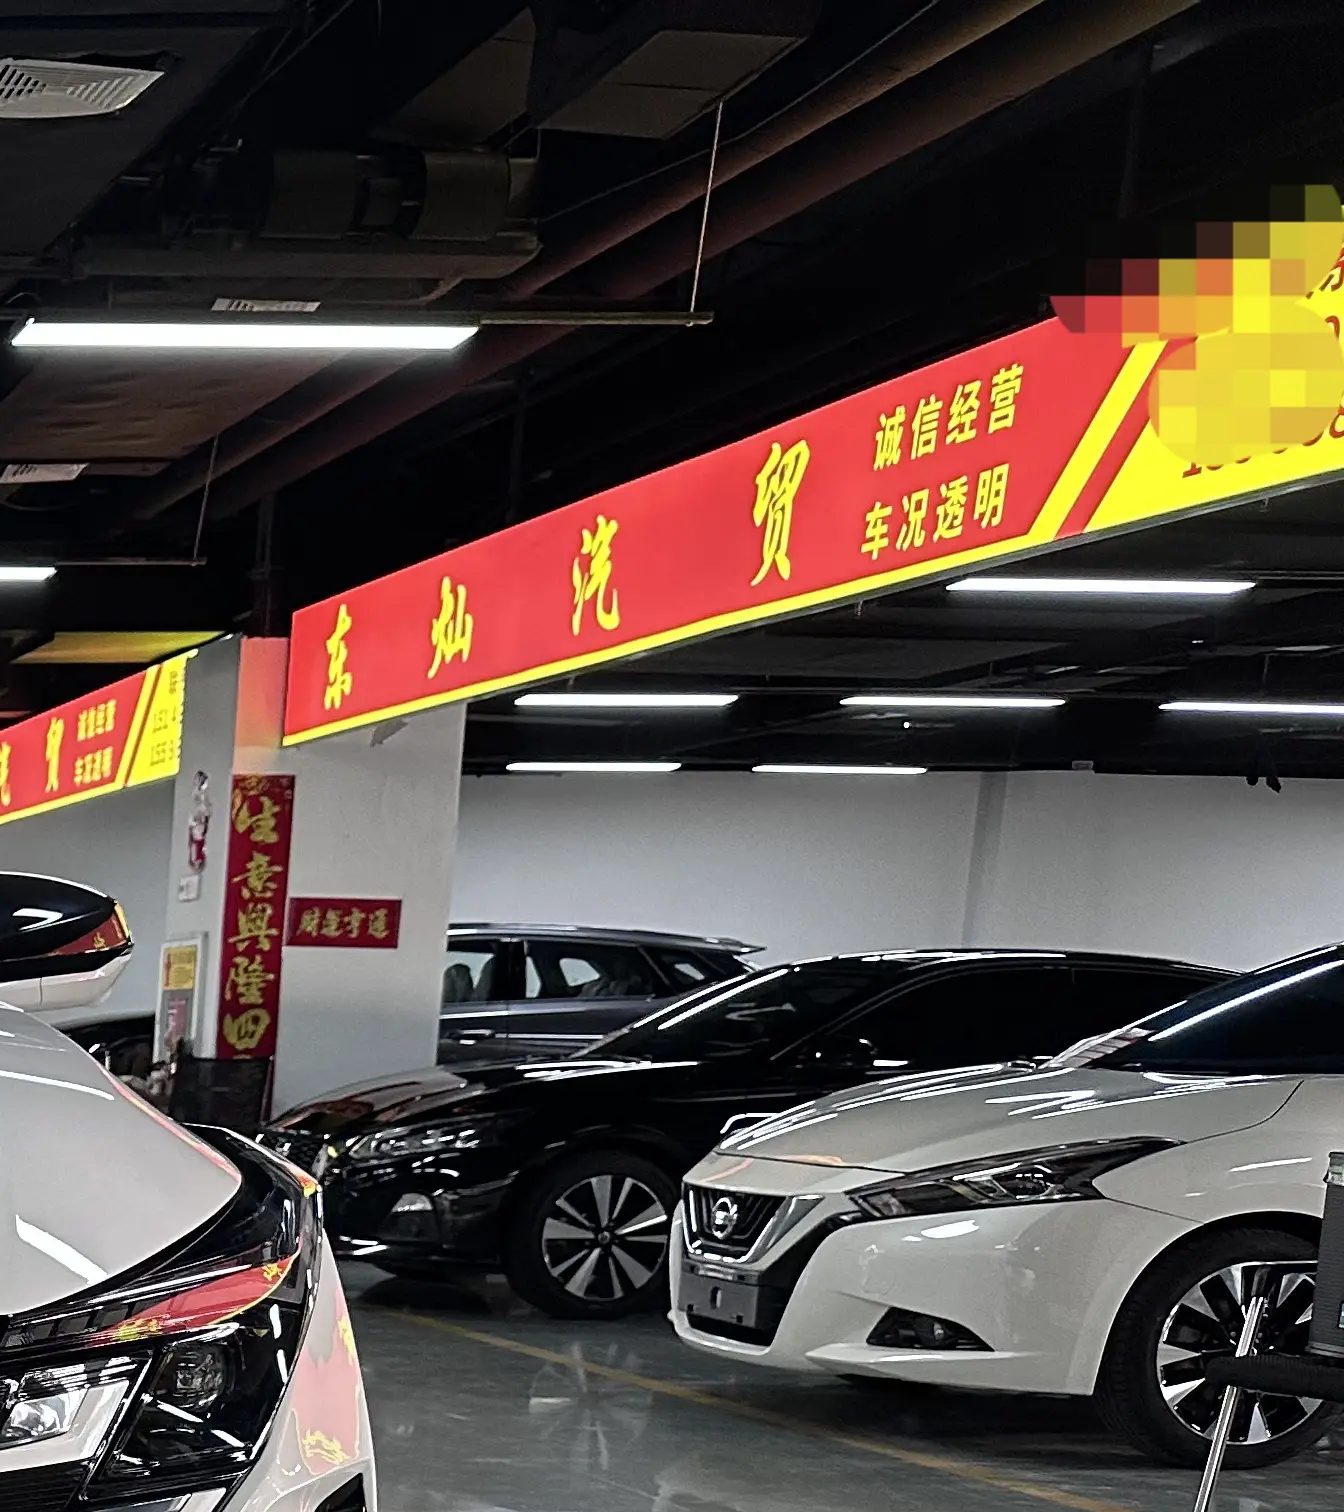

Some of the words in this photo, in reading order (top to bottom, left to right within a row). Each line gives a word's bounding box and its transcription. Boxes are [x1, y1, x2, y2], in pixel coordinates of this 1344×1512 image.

[873, 363, 1024, 471] 诚信经营
[861, 463, 1010, 560] 车况透明
[223, 796, 283, 1059] 生意興隆四
